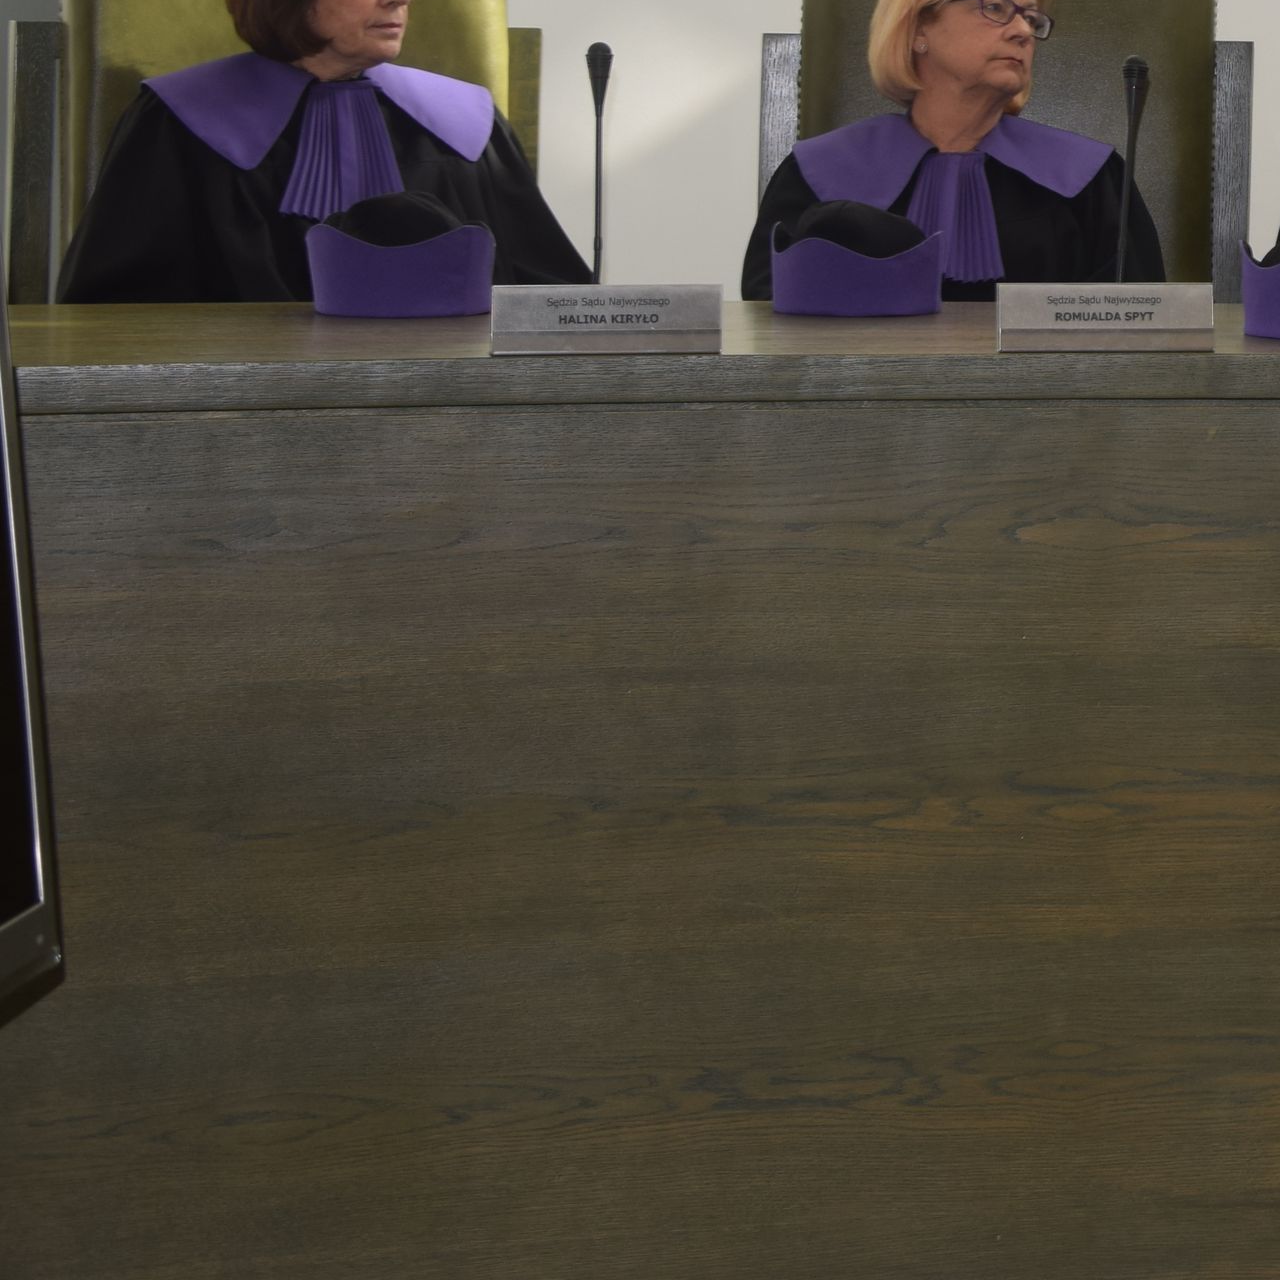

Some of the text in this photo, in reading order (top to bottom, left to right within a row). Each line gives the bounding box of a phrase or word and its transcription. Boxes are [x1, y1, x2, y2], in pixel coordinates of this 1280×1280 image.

[547, 297, 578, 309] Sędzia
[582, 297, 605, 309] Sądu
[1047, 296, 1161, 306] Sędzia Sądu Najwyższego
[559, 314, 659, 324] HALINA KIRYŁO
[1055, 312, 1154, 321] ROMUALDA SPYT
